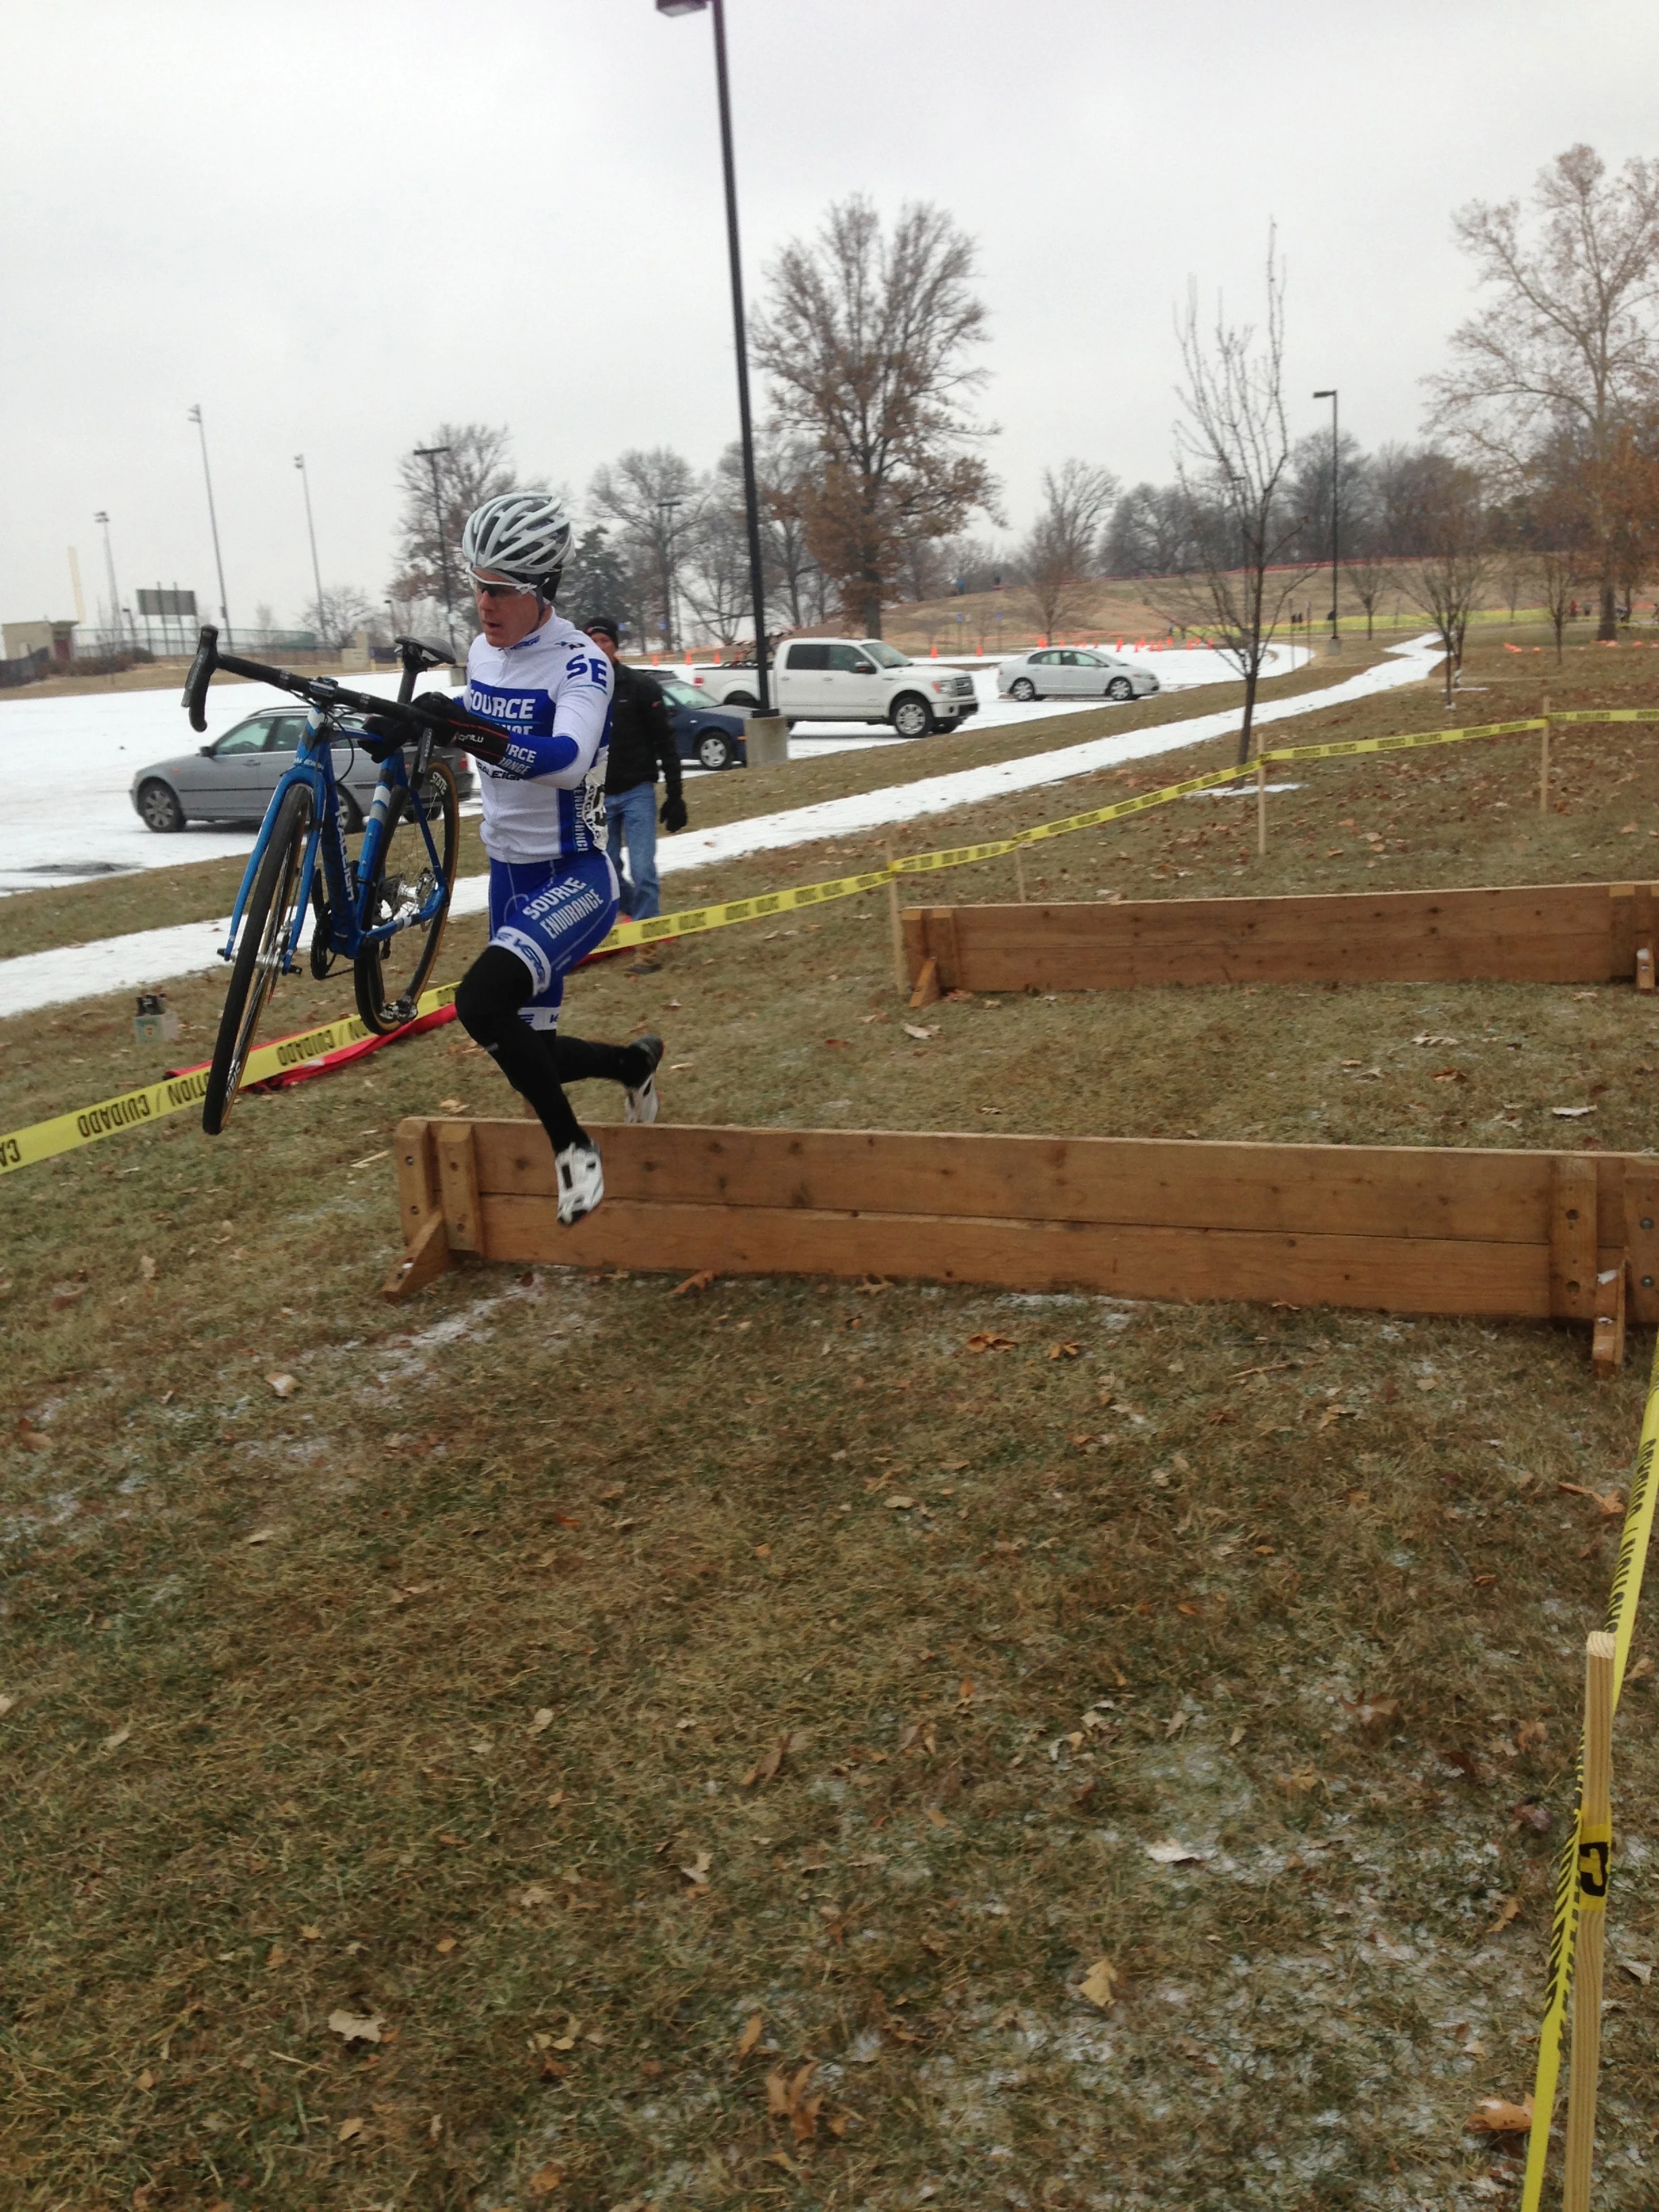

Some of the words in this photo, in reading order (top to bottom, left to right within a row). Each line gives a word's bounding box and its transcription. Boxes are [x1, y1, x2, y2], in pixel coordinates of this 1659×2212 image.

[566, 654, 607, 688] SE
[523, 877, 588, 920] SOURCE
[539, 888, 605, 940] ENDURANCE
[276, 1029, 335, 1067] CUIDADO
[77, 1094, 151, 1139] CUIDADO
